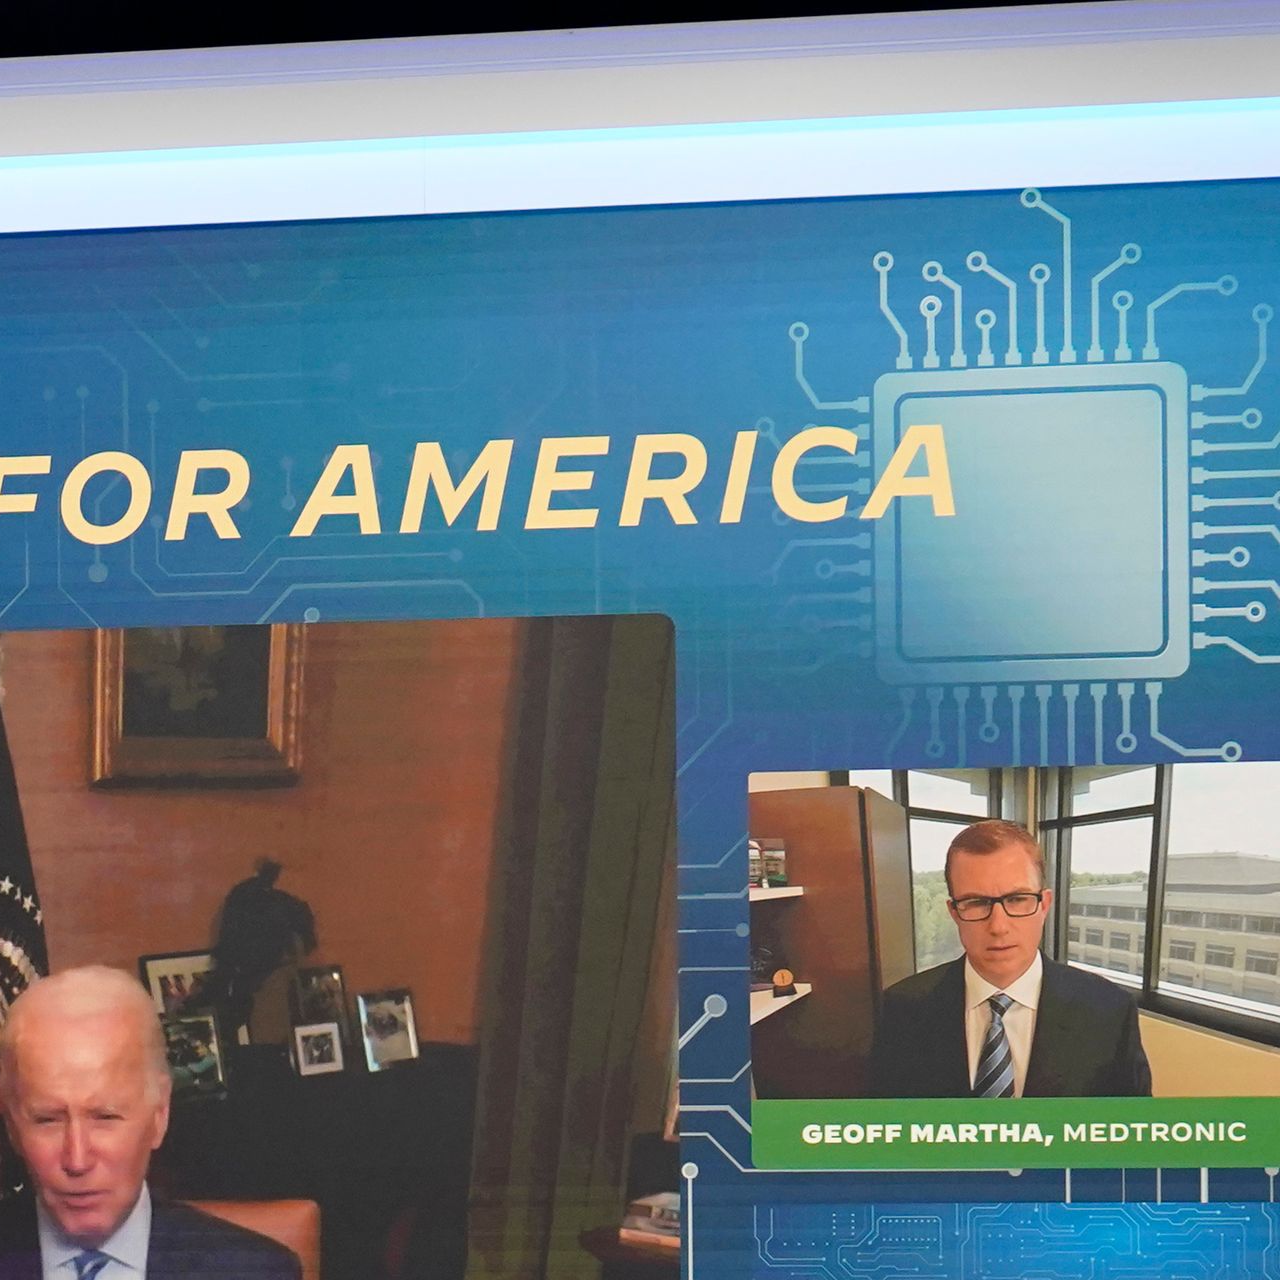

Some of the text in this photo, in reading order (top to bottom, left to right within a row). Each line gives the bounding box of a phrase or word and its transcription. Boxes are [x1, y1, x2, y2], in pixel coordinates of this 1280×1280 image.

[290, 425, 956, 538] AMERICA
[801, 1121, 1247, 1147] GEOFF MARTHA, MEDTRONIC
